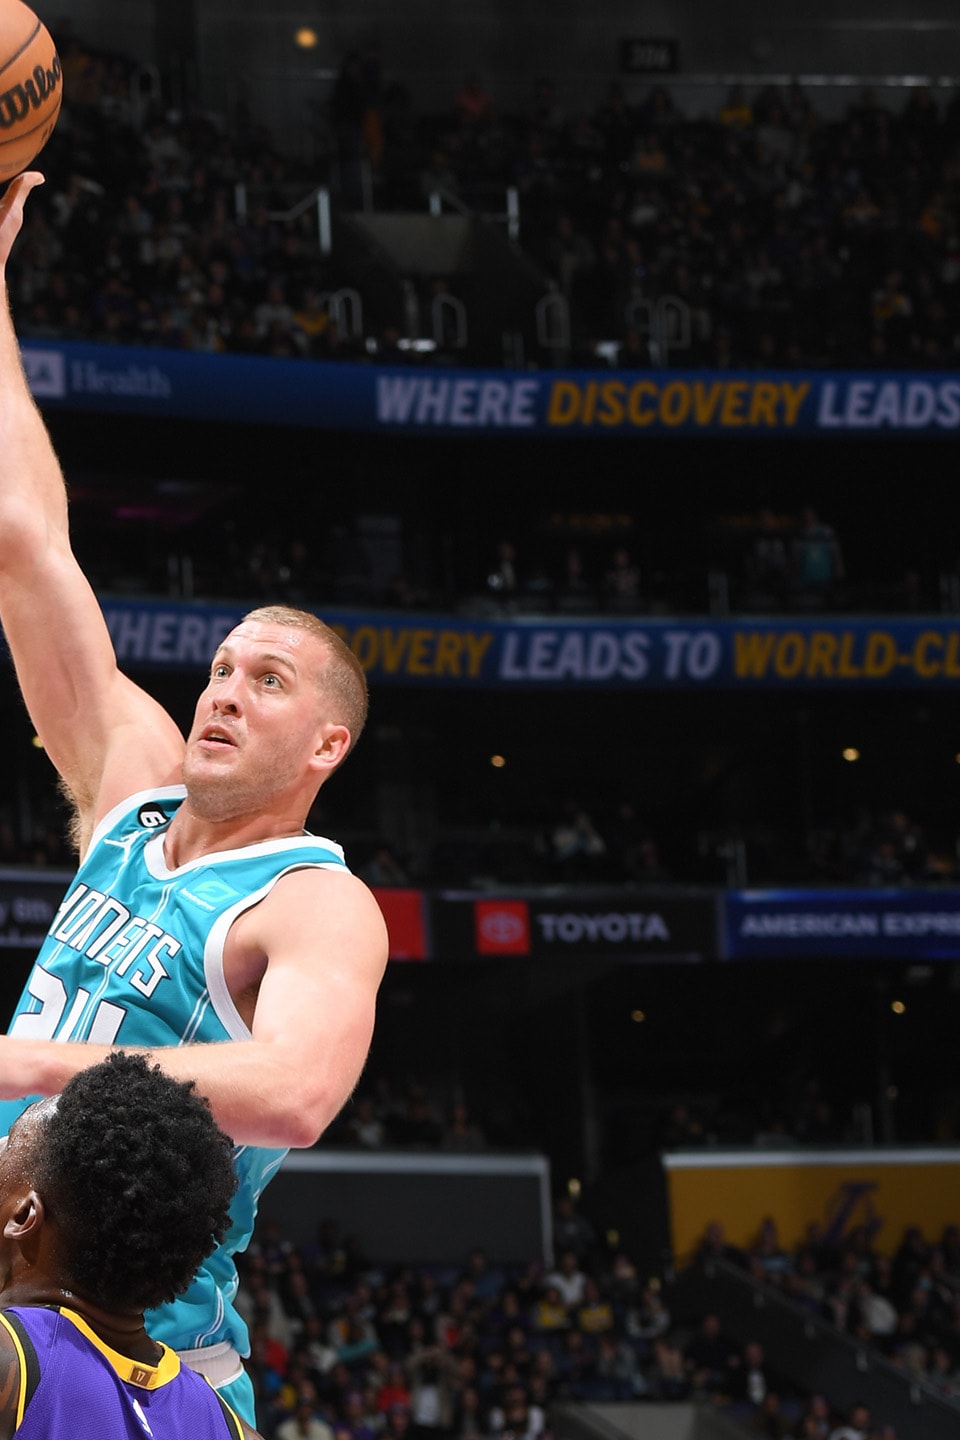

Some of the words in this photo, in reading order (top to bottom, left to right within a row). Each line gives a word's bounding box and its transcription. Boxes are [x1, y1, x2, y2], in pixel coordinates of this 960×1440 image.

[71, 358, 172, 399] Health
[375, 375, 539, 427] WHERE
[547, 379, 811, 428] DISCOVERY
[816, 381, 960, 428] LEADS
[109, 609, 238, 667] HERE
[499, 631, 651, 681] LEADS
[662, 631, 721, 680] TO
[140, 811, 167, 828] 6
[536, 912, 671, 943] TOYOTA
[742, 912, 879, 938] AMERICAN
